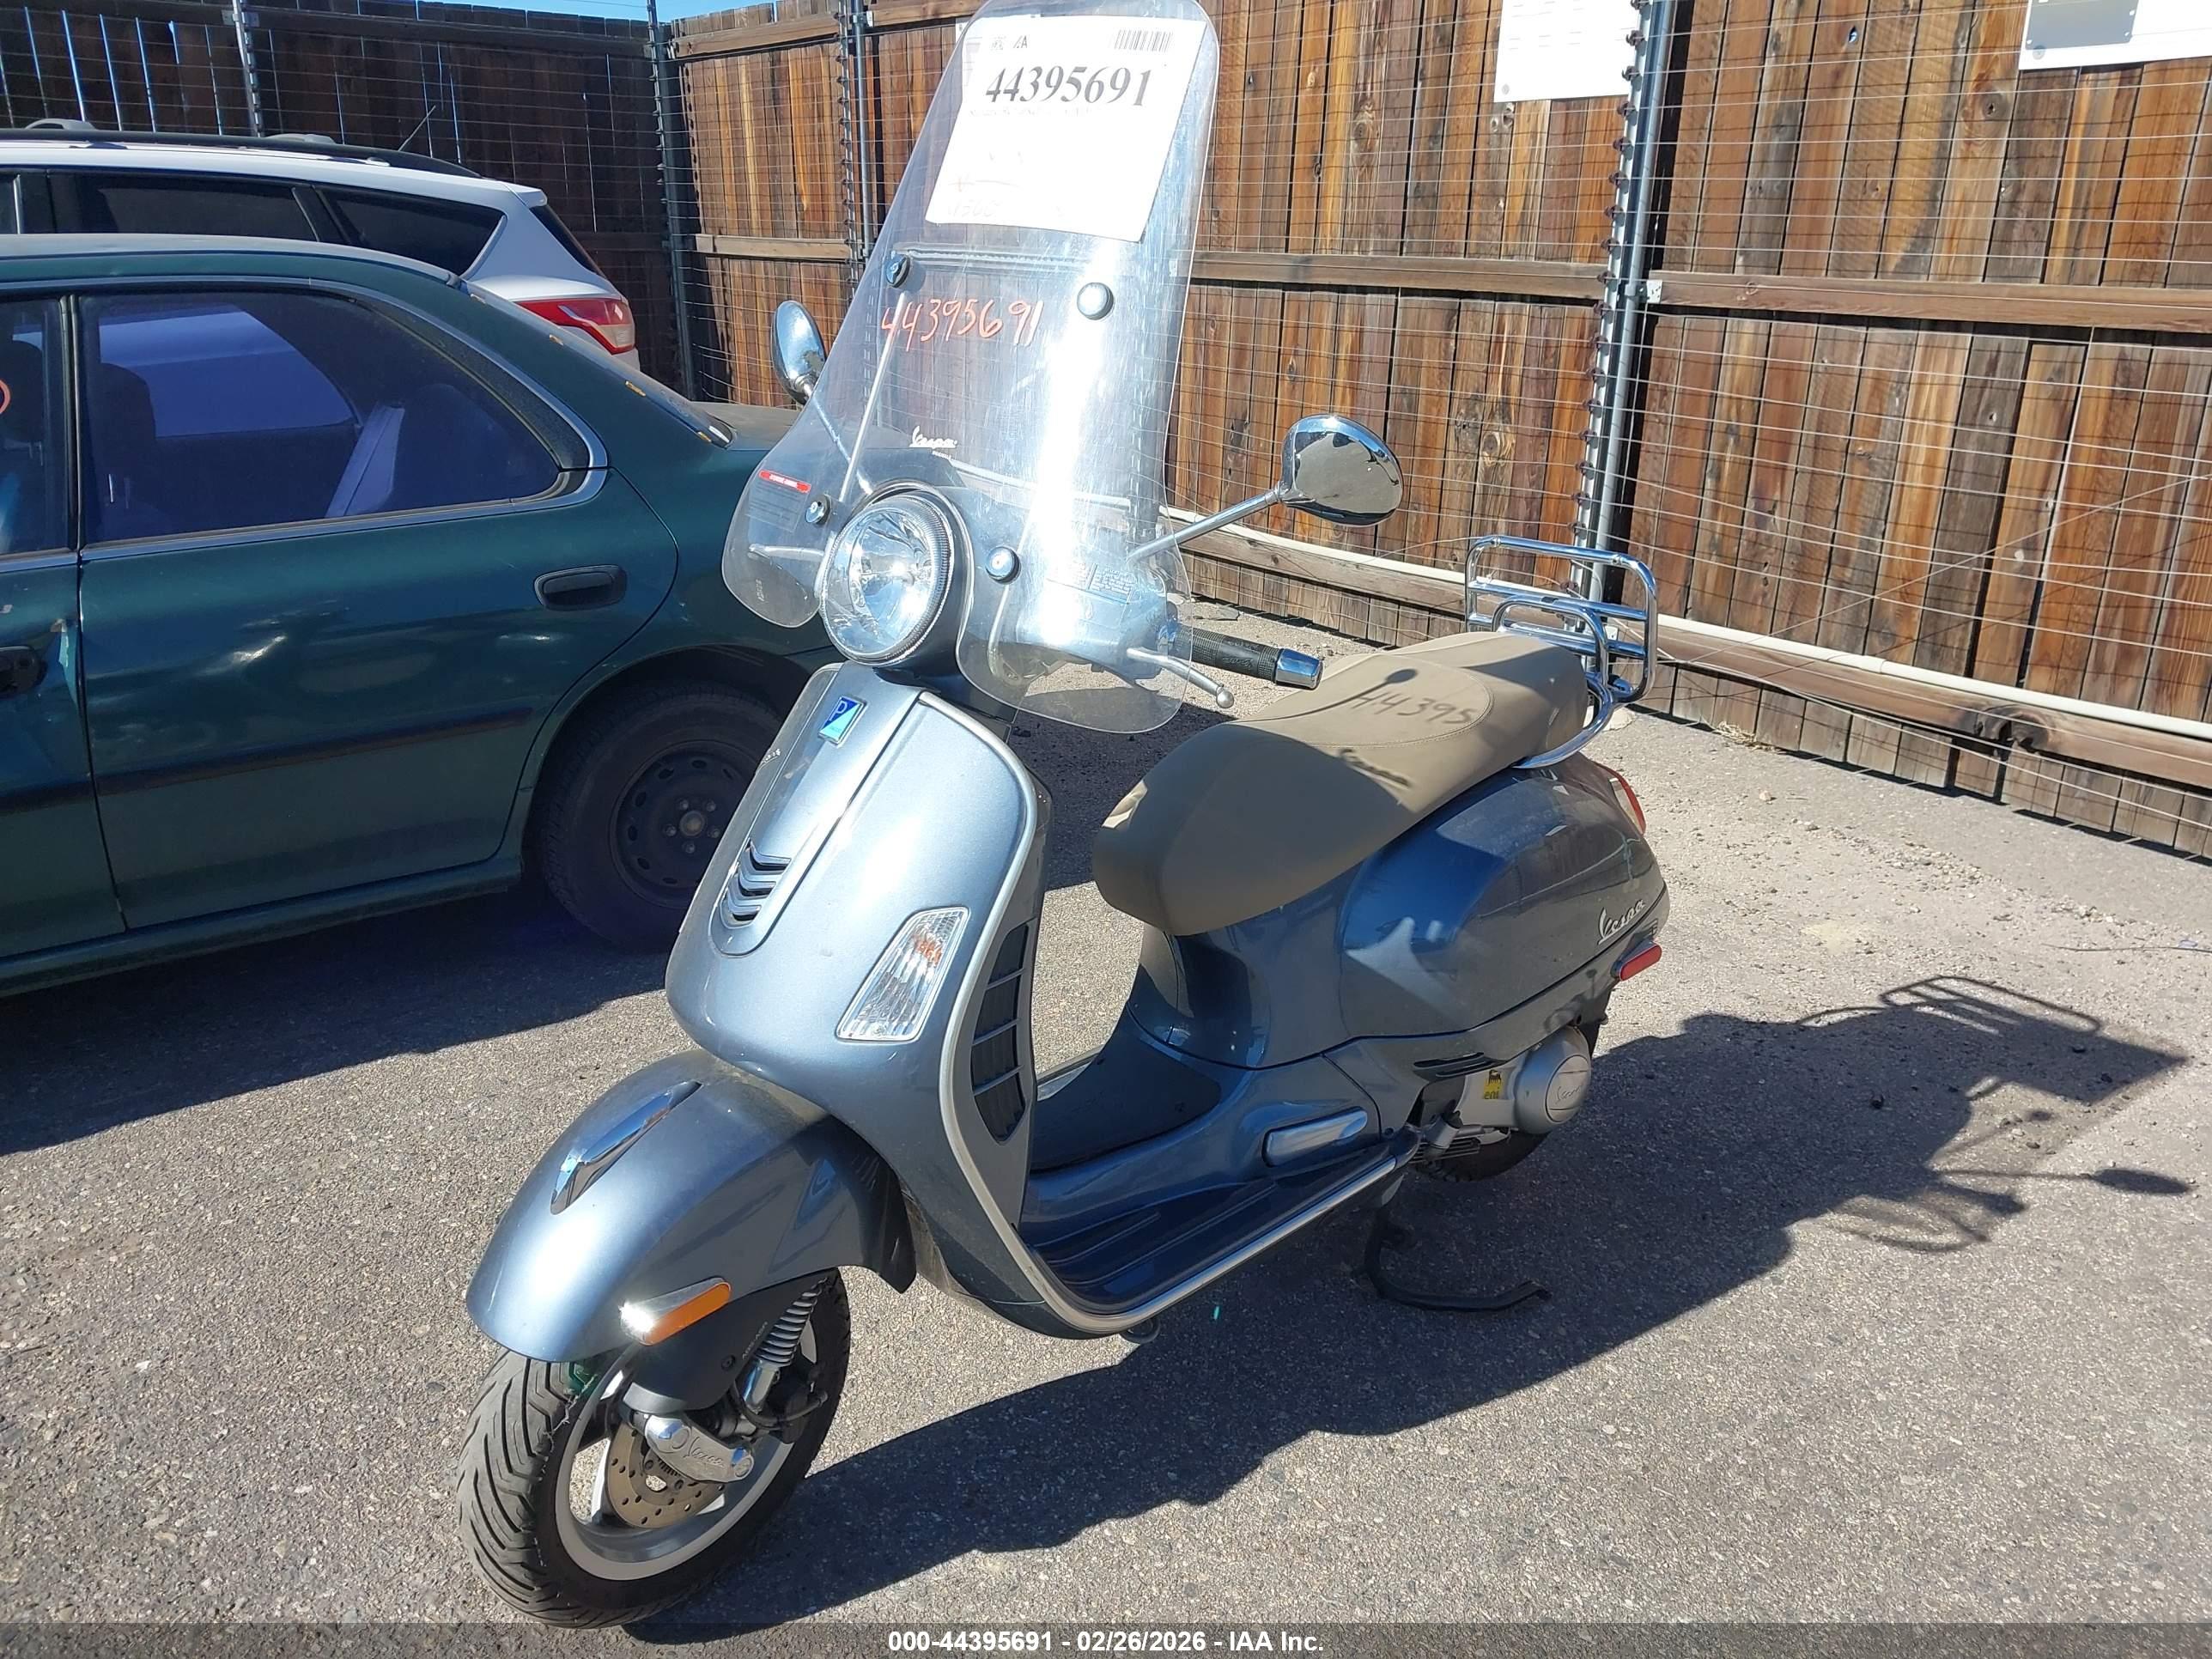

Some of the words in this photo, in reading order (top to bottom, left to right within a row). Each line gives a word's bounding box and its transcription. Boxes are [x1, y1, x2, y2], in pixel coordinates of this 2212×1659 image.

[985, 65, 1152, 106] 44395691
[881, 298, 1044, 352] 44395691
[1596, 897, 1647, 945] Vespa
[1483, 1085, 1499, 1099] eni
[684, 1436, 724, 1468] Vespa
